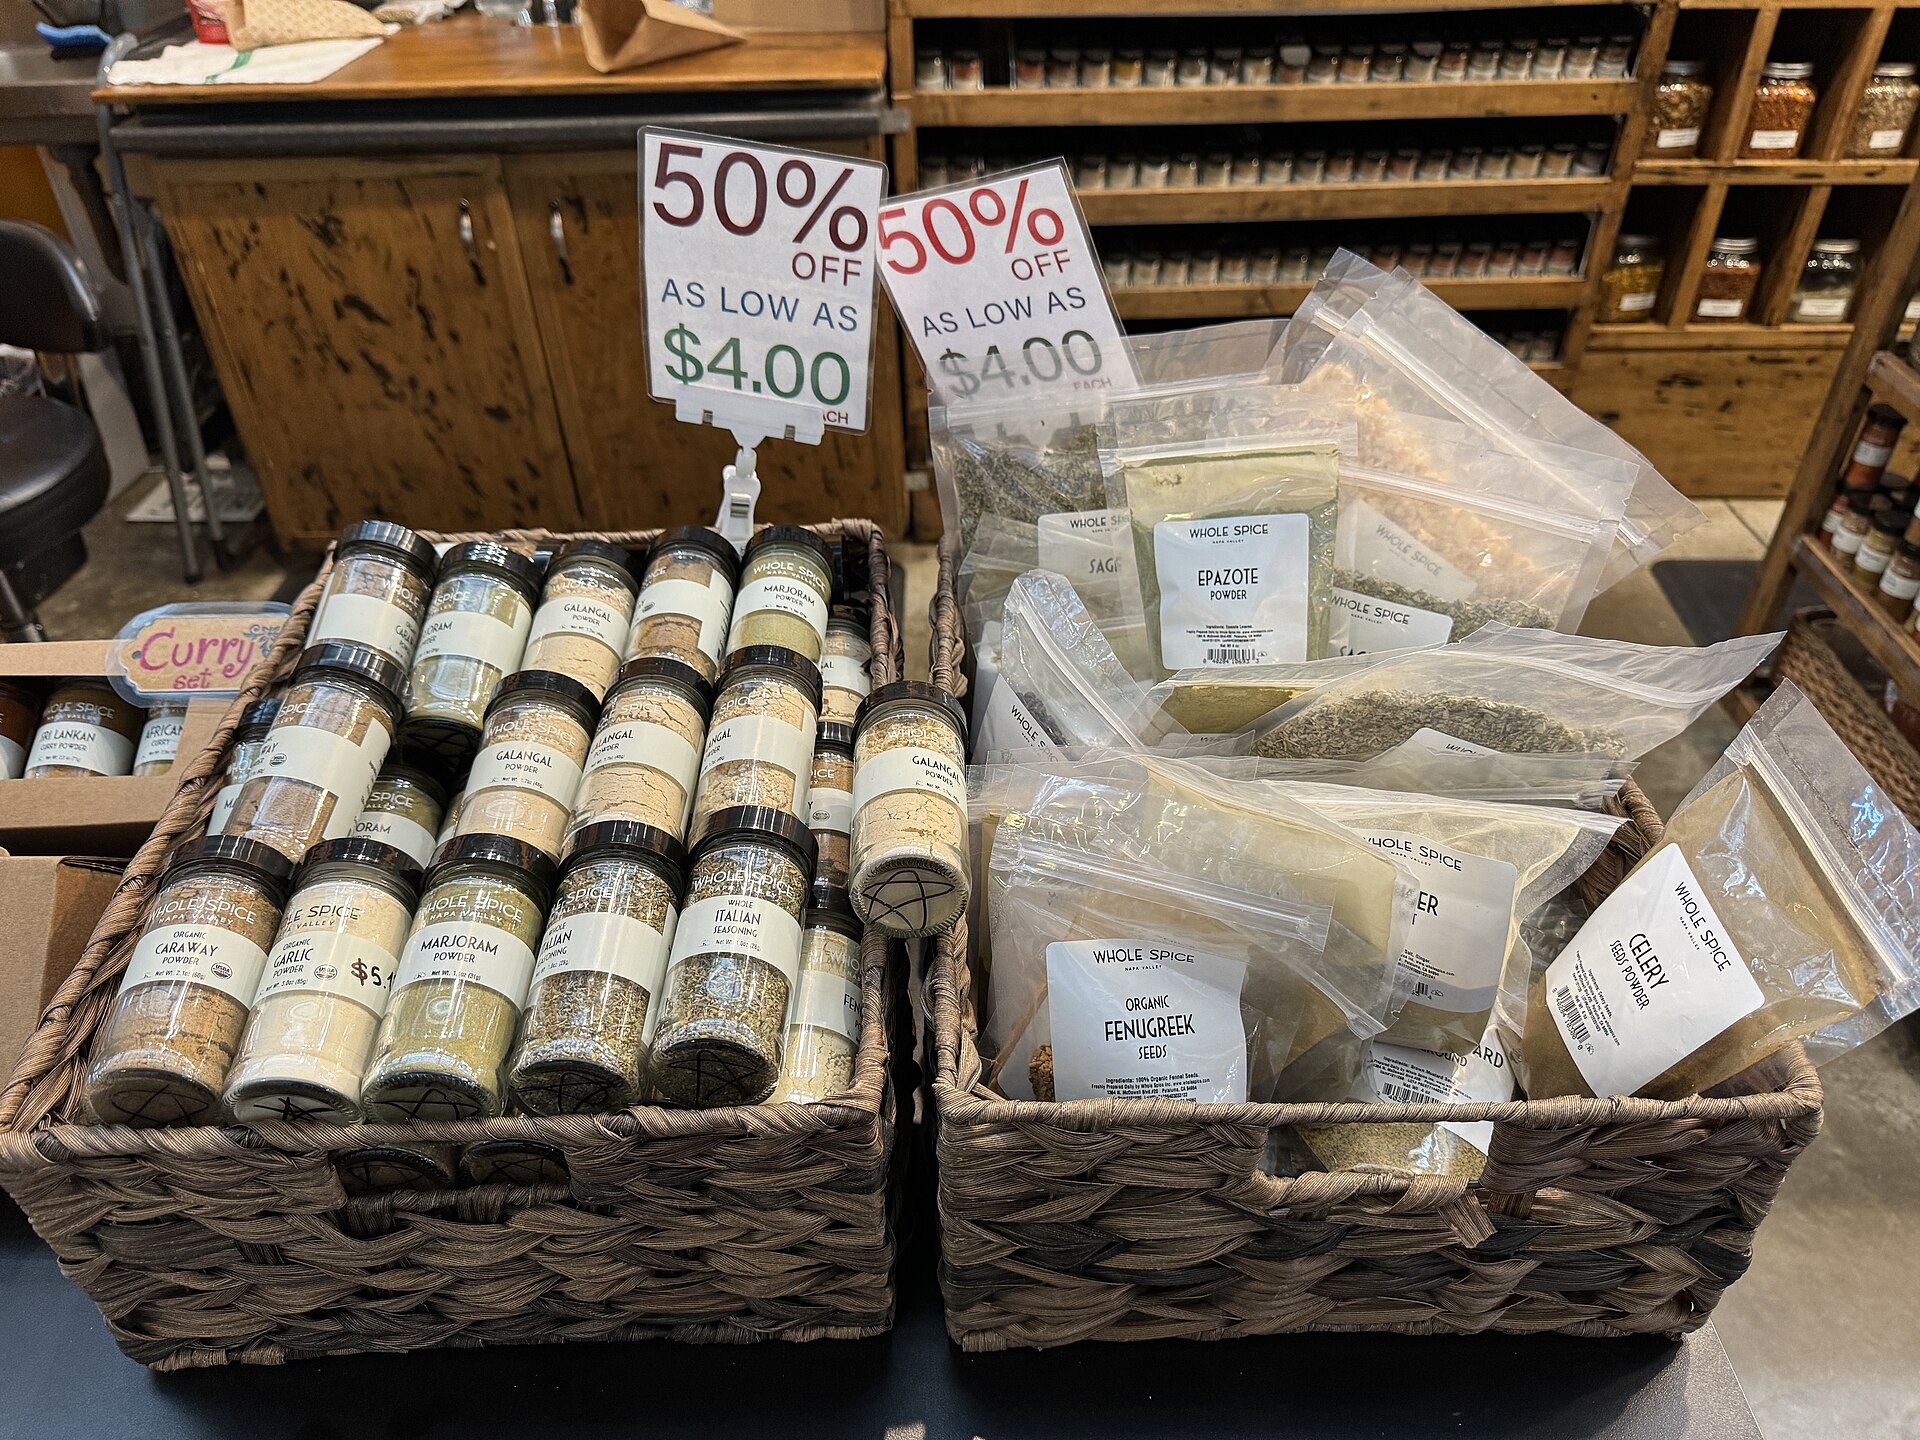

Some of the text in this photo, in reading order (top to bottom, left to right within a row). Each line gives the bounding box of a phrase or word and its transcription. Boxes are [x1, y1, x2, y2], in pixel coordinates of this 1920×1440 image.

[653, 142, 868, 253] 50%
[878, 178, 1065, 275] 50%
[791, 252, 862, 287] OFF
[1010, 249, 1071, 282] OFF
[661, 279, 859, 332] AS LOW AS
[922, 286, 1086, 338] AS LOW AS
[664, 323, 851, 405] $4.00
[938, 329, 1103, 401] $4.00
[1069, 516, 1107, 529] WHOLE
[1189, 523, 1269, 539] WHOLE SPICE
[1375, 524, 1443, 577] WHOLE SPICE
[753, 561, 826, 594] WHOLE SPICE
[791, 572, 816, 588] VALLEY
[1198, 567, 1259, 587] EPAZOTE
[763, 584, 816, 607] MARJORAM
[775, 594, 804, 608] POWDER
[1210, 589, 1248, 601] POWDER
[564, 603, 612, 624] GALANGAL
[1331, 595, 1411, 625] WHOLE SPICE
[572, 614, 601, 627] POWDER
[140, 627, 255, 679] Curry
[172, 668, 212, 691] set
[75, 702, 116, 720] SPICE
[279, 702, 317, 718] SPICE
[720, 694, 755, 714] SPICE
[1011, 704, 1039, 742] WHOLE
[53, 728, 97, 743] LANKAN
[487, 718, 530, 738] WHOLE
[536, 722, 577, 748] SPICE
[887, 726, 940, 743] WHOLE
[496, 749, 553, 769] GALANGAL
[504, 763, 539, 775] POWDER
[911, 755, 962, 786] GALANGAL
[925, 769, 955, 788] POWDER
[370, 791, 414, 809] SPICE
[1410, 857, 1432, 867] VALLEY
[1419, 845, 1463, 872] SPICE
[693, 869, 794, 900] WHOLE SPICE
[566, 886, 613, 904] SPICE
[727, 899, 754, 909] WHOLE
[148, 898, 257, 925] WHOLE SPICE
[307, 904, 361, 921] SPICE
[423, 895, 523, 923] WHOLE SPICE
[429, 910, 503, 923] NAPA VALLEY
[714, 909, 762, 926] ITALIAN
[159, 912, 234, 926] NAPA VALLEY
[296, 919, 335, 930] VALLEY
[1675, 881, 1732, 972] WHOLE SPICE
[1680, 916, 1688, 930] NAPA
[173, 930, 208, 939] ORGANIC
[712, 925, 758, 938] SEASONING
[155, 941, 219, 957] CARAWAY
[282, 938, 312, 951] ORGANIC
[420, 935, 499, 956] MARJORAM
[161, 956, 200, 966] POWDER
[273, 947, 315, 968] GARLIC
[433, 951, 476, 963] POWDER
[1092, 948, 1195, 964] WHOLE SPICE
[1628, 933, 1670, 990] CELERY
[272, 964, 305, 979] POWDER
[1609, 939, 1650, 1010] SEEDS POWDER
[1125, 994, 1170, 1012] ORGANIC
[1597, 991, 1606, 1005] Celery
[1104, 1013, 1196, 1042] FENUGREEK
[1138, 1044, 1168, 1060] SEEDS
[1150, 1075, 1168, 1083] Organic
[1168, 1073, 1184, 1081] Fennel
